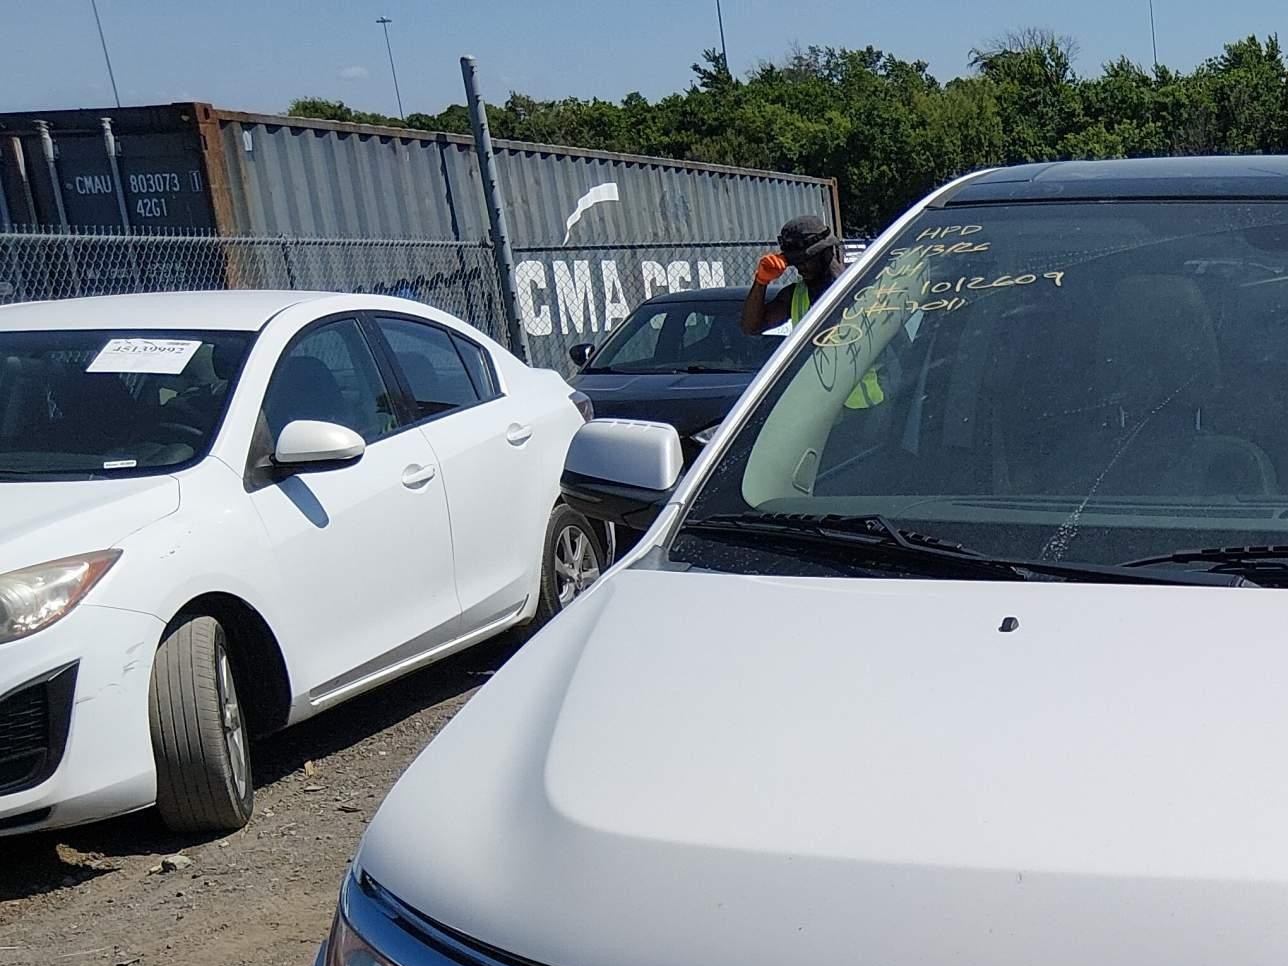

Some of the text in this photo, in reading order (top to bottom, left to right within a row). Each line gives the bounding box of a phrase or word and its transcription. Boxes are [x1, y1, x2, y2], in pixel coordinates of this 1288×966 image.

[75, 174, 112, 194] CMAU
[129, 172, 180, 193] 803073
[136, 198, 168, 217] 42G1
[916, 224, 983, 242] HPD
[515, 260, 630, 336] CMA
